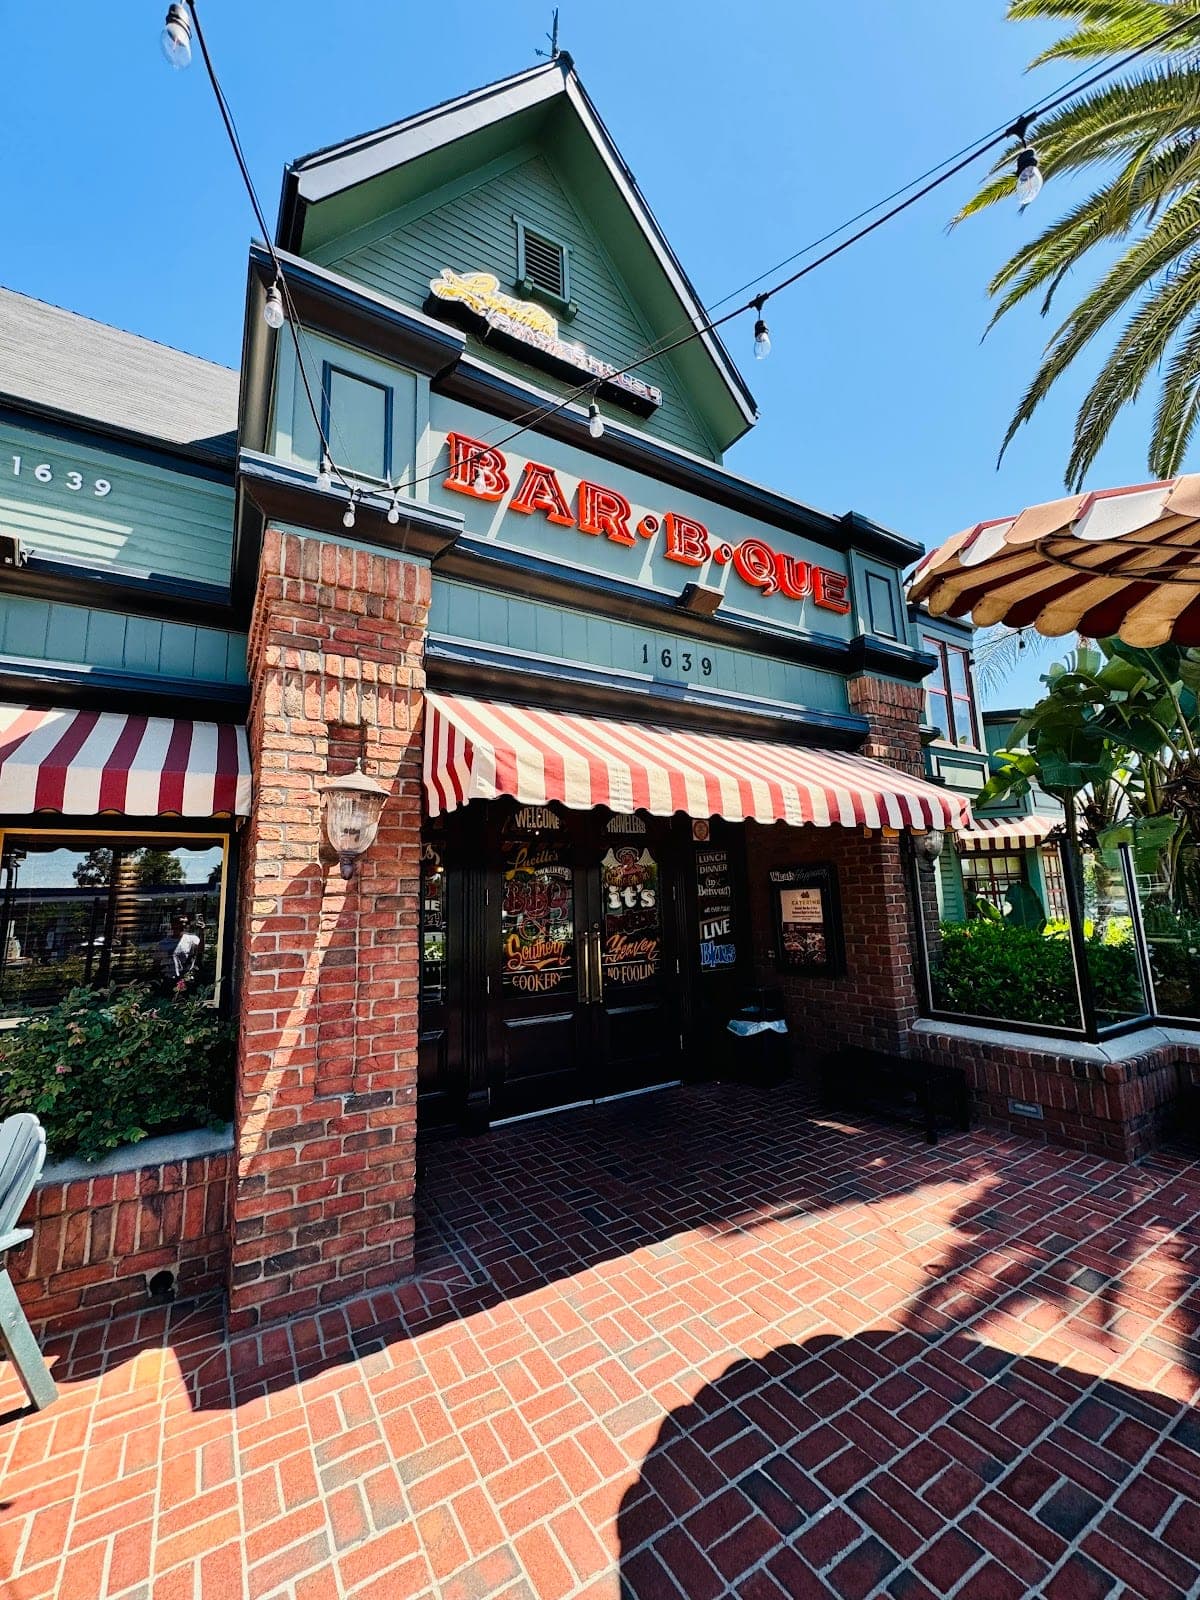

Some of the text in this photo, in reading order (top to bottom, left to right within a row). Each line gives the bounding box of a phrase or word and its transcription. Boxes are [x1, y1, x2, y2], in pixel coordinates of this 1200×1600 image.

[12, 455, 111, 497] 1639
[641, 643, 713, 676] 1639
[515, 806, 560, 829] WELCOME
[607, 815, 646, 832] TRAVELERS
[698, 853, 728, 864] LUNCH
[699, 863, 729, 874] DINNER
[501, 880, 569, 919] BBQ
[608, 884, 656, 908] it's
[703, 918, 731, 939] LIVE
[505, 933, 571, 970] Southern
[511, 971, 561, 992] COOKERY
[607, 966, 620, 981] NO
